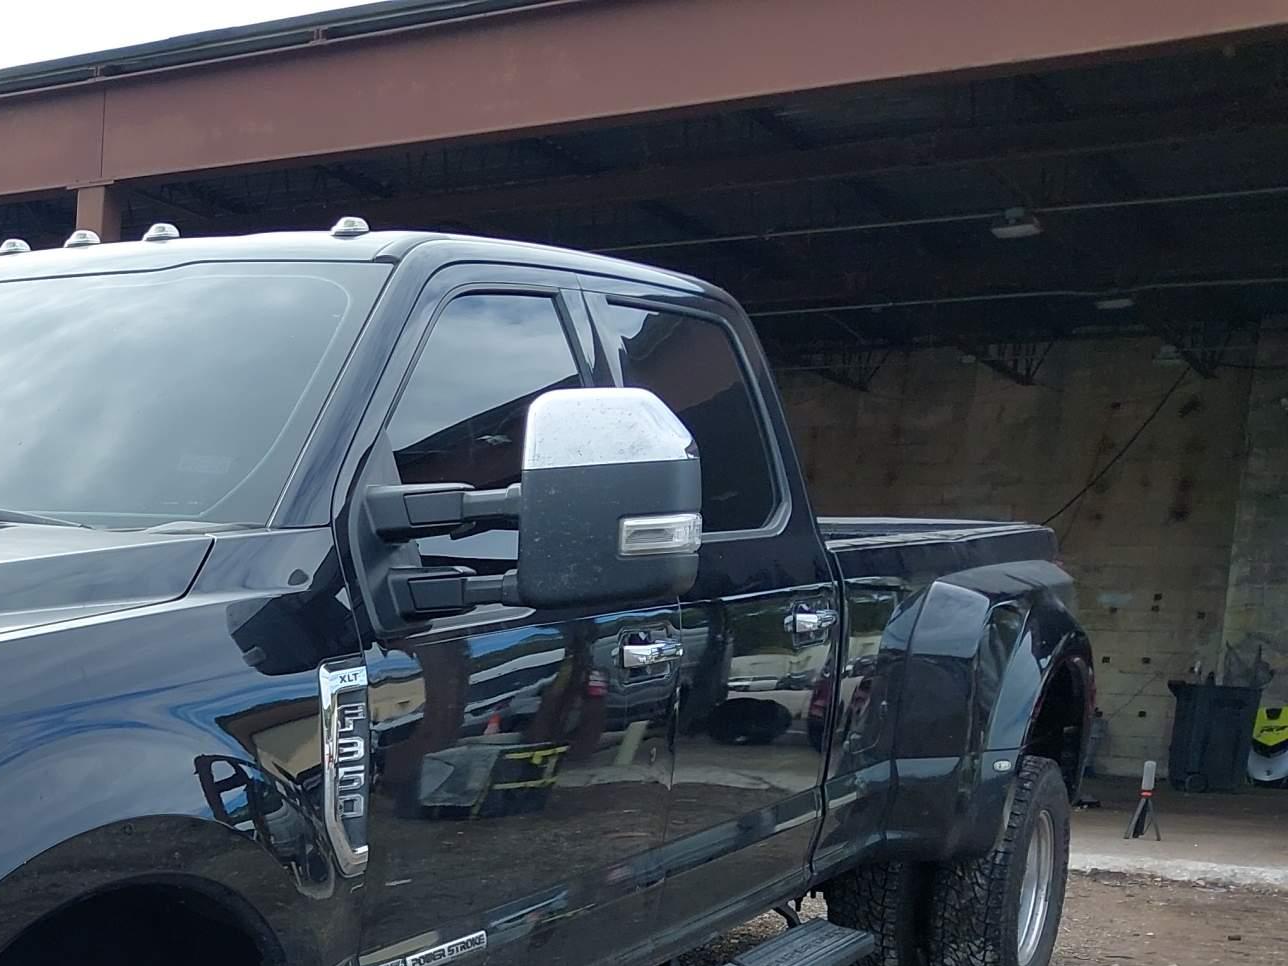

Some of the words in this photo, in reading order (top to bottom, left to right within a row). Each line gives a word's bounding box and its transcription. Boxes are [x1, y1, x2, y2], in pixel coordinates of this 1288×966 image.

[339, 672, 360, 684] XLT
[337, 701, 366, 819] F350
[447, 934, 485, 957] STROKE
